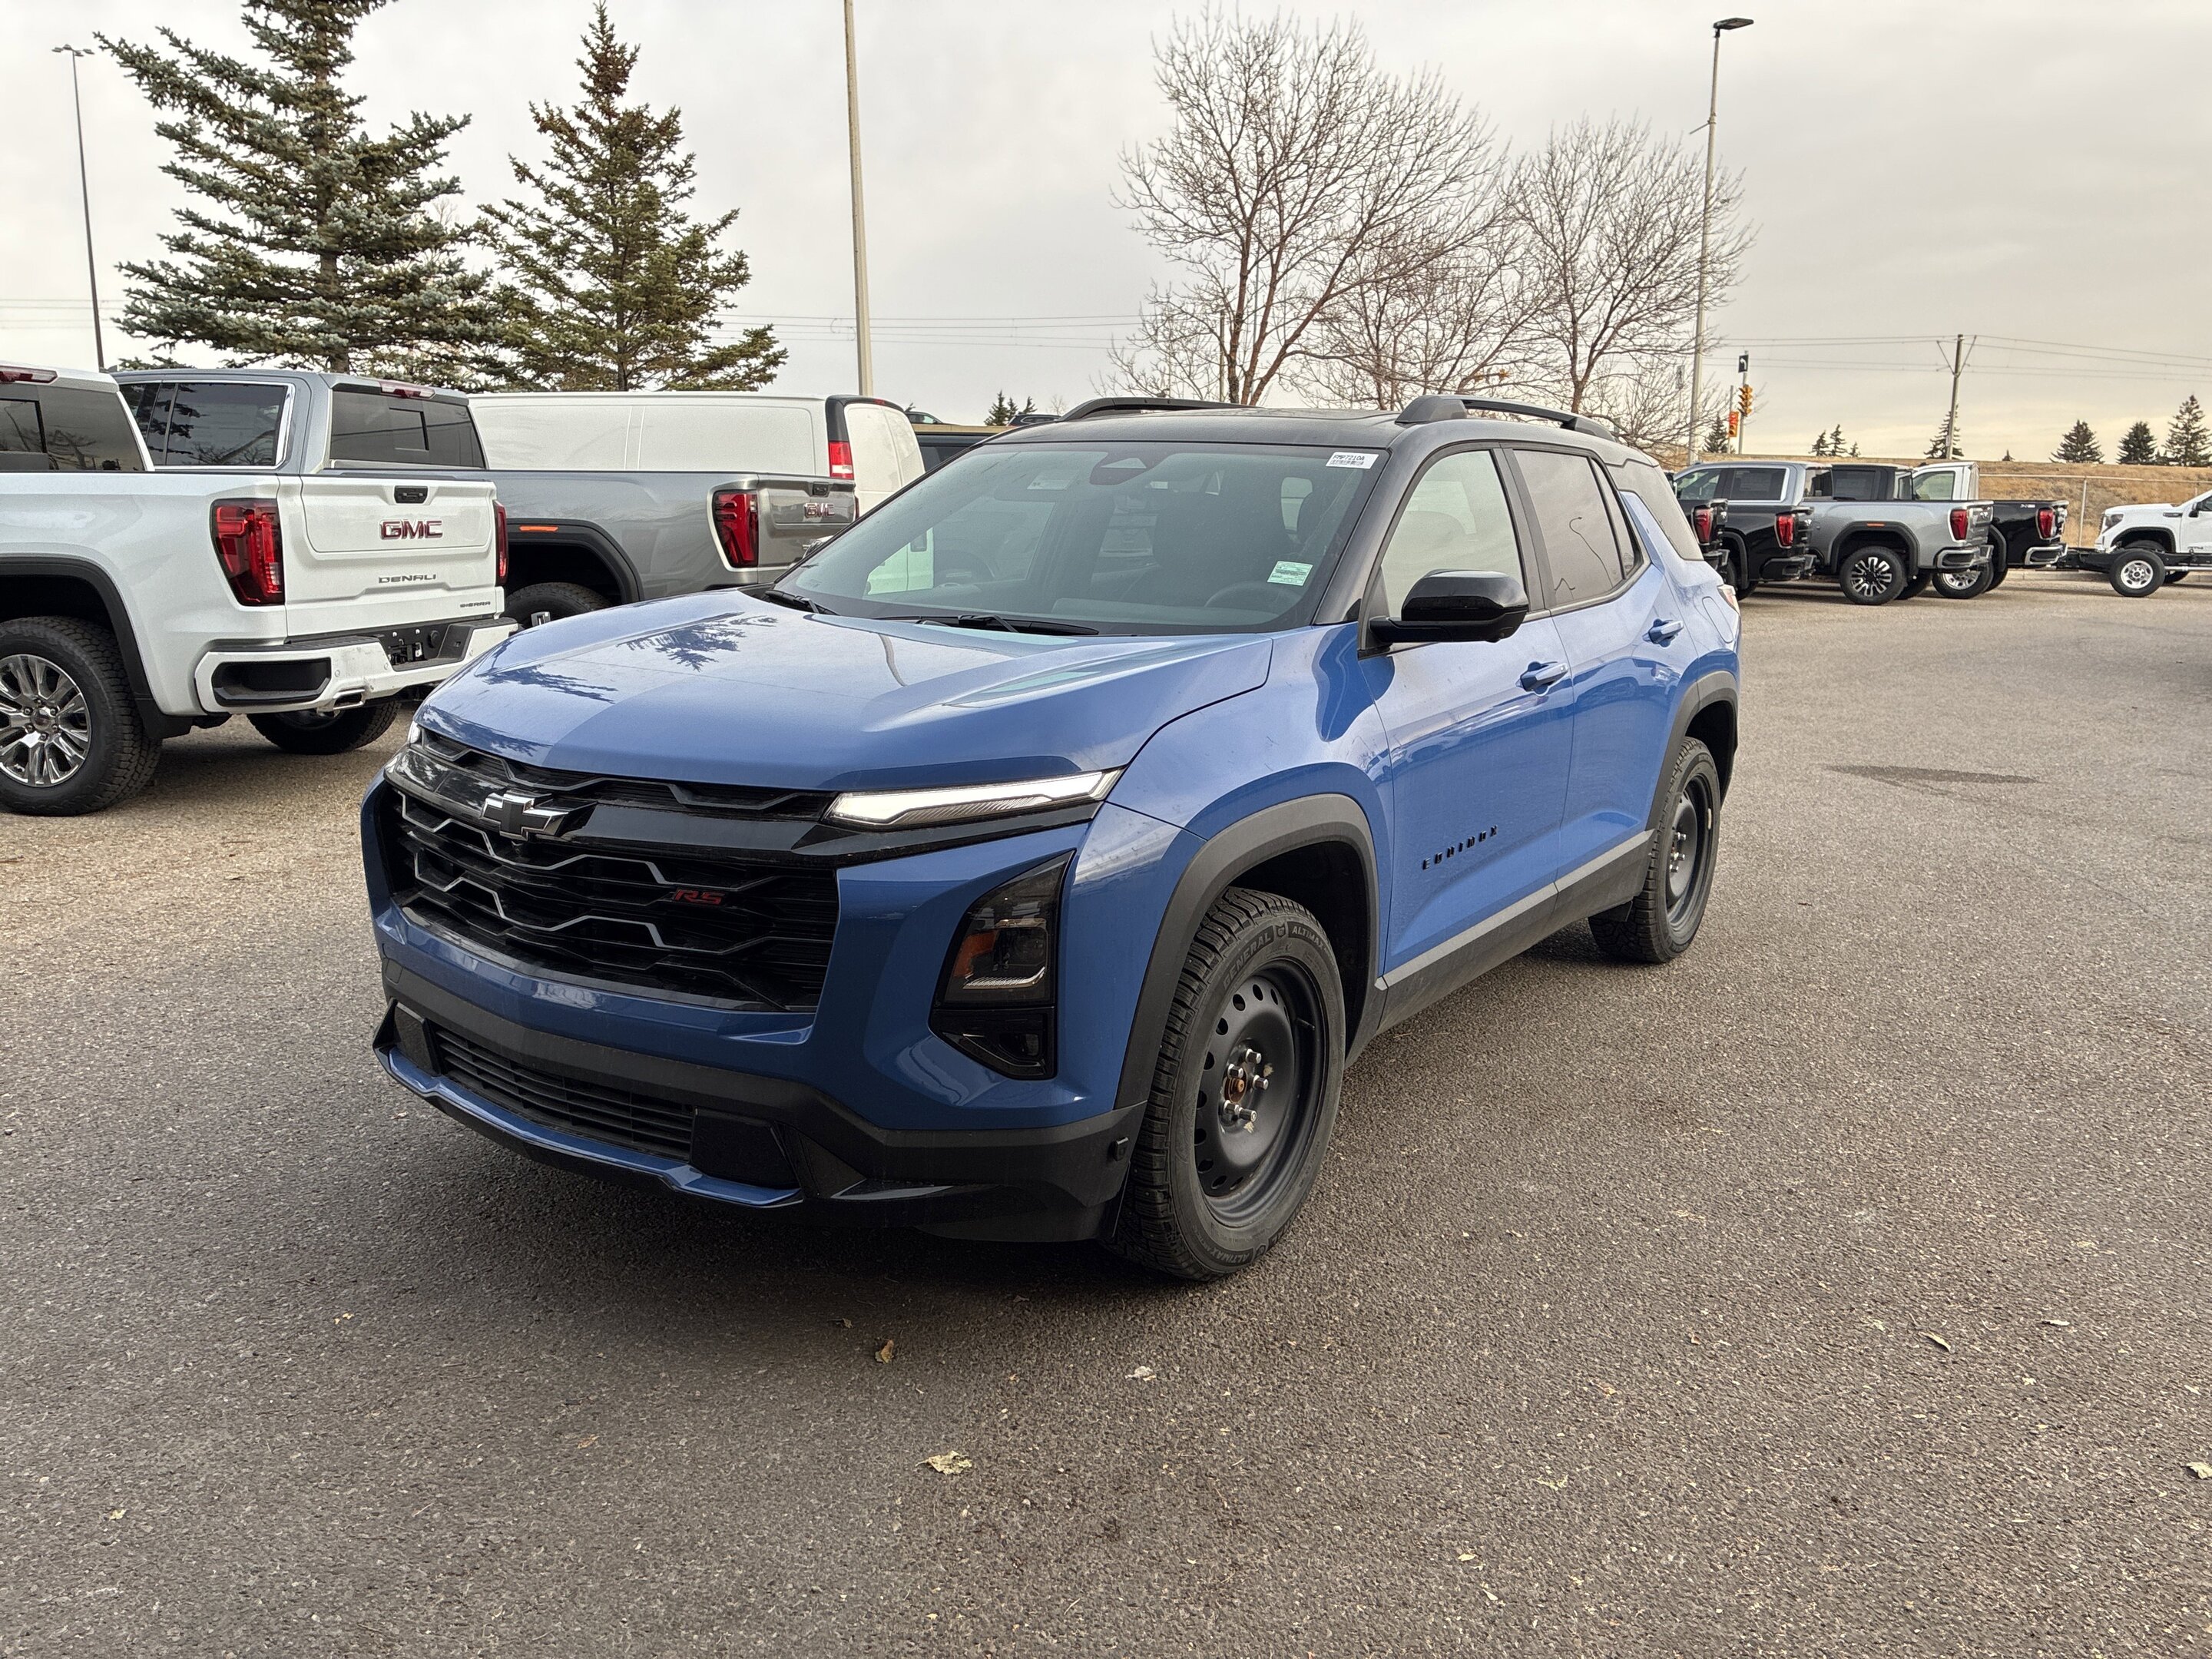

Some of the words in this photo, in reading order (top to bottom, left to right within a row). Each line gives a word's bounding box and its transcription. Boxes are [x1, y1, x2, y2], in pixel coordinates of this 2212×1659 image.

[803, 502, 836, 518] GMC
[379, 518, 444, 540] GMC
[378, 574, 437, 584] DENALI
[1422, 824, 1498, 870] EQUINOX
[675, 889, 725, 906] RS
[1222, 932, 1273, 990] GENERAL
[1290, 925, 1324, 949] ALTIMAX
